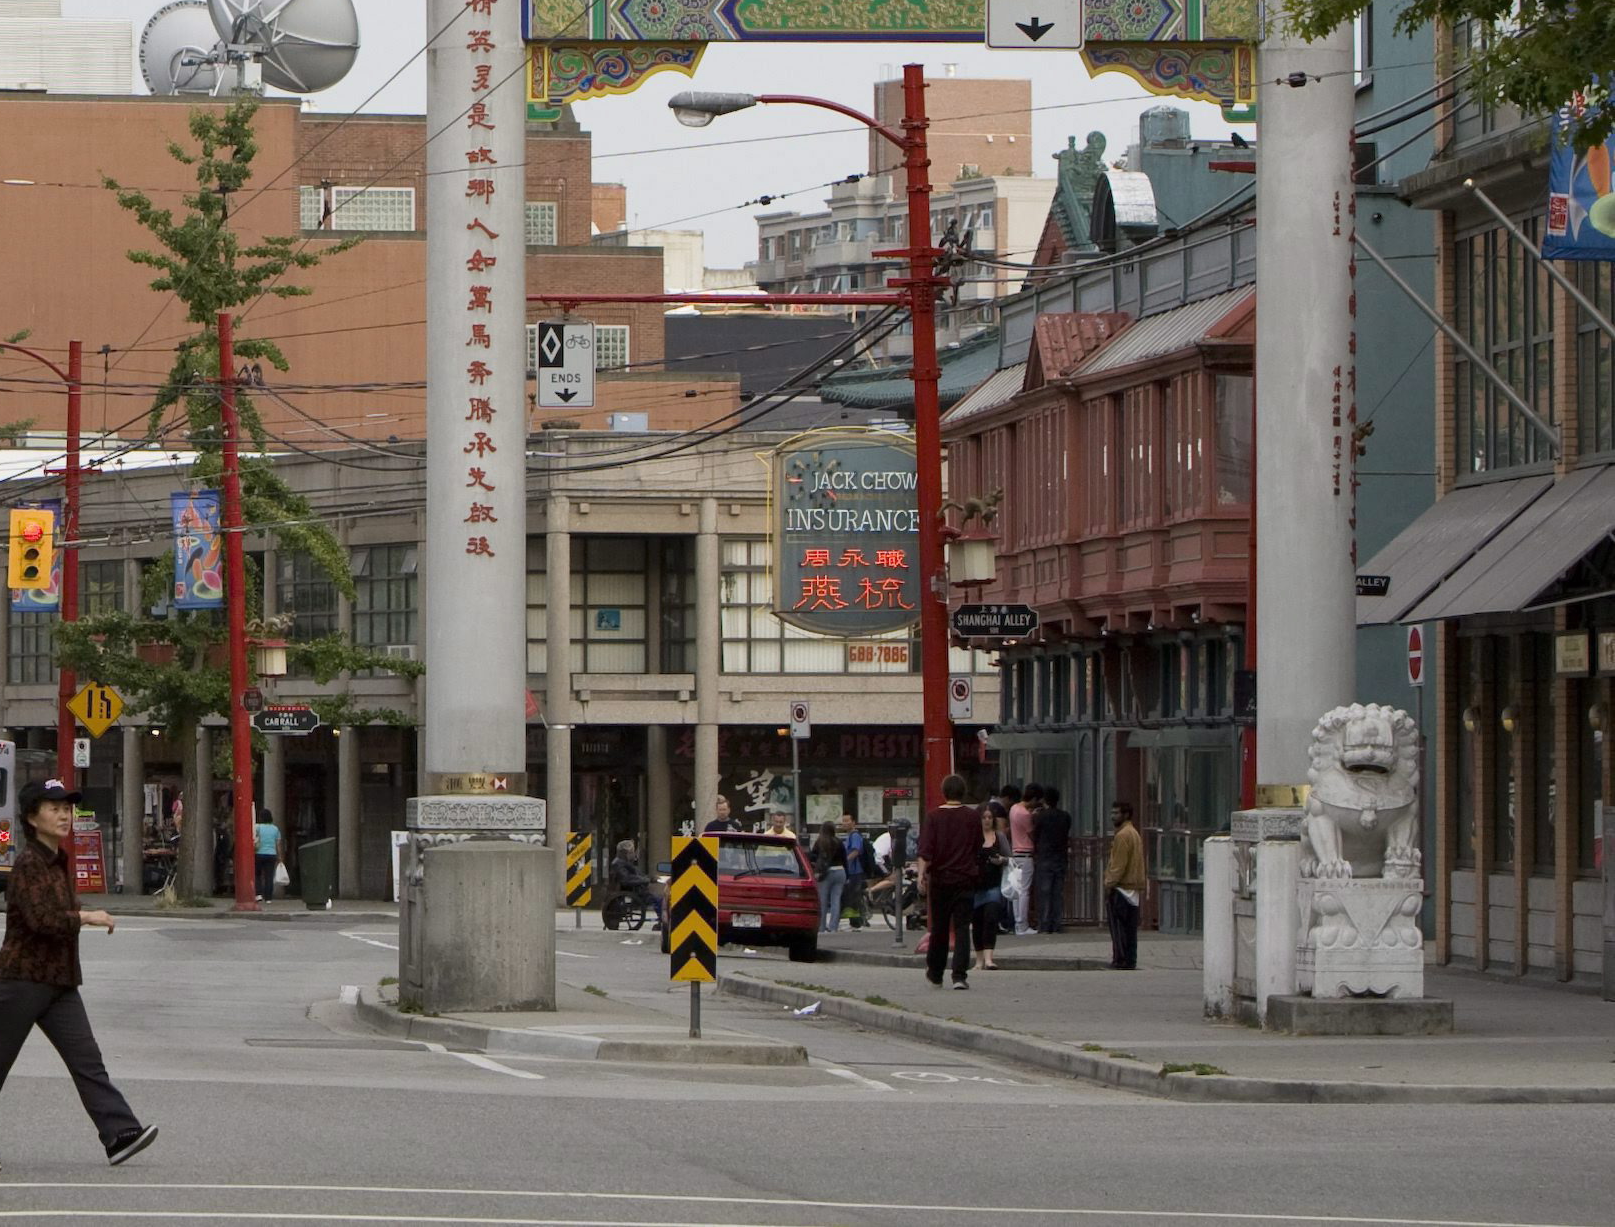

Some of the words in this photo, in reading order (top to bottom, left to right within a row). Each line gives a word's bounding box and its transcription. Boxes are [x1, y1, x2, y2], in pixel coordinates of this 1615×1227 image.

[551, 373, 581, 383] ENDS
[811, 471, 858, 493] JACK
[861, 471, 918, 490] CHOW
[786, 508, 920, 532] INSURANCE
[957, 615, 1001, 626] SHANGHAI
[1004, 614, 1032, 626] ALLEY
[265, 717, 299, 727] CARRALL
[840, 734, 924, 758] PRESTI
